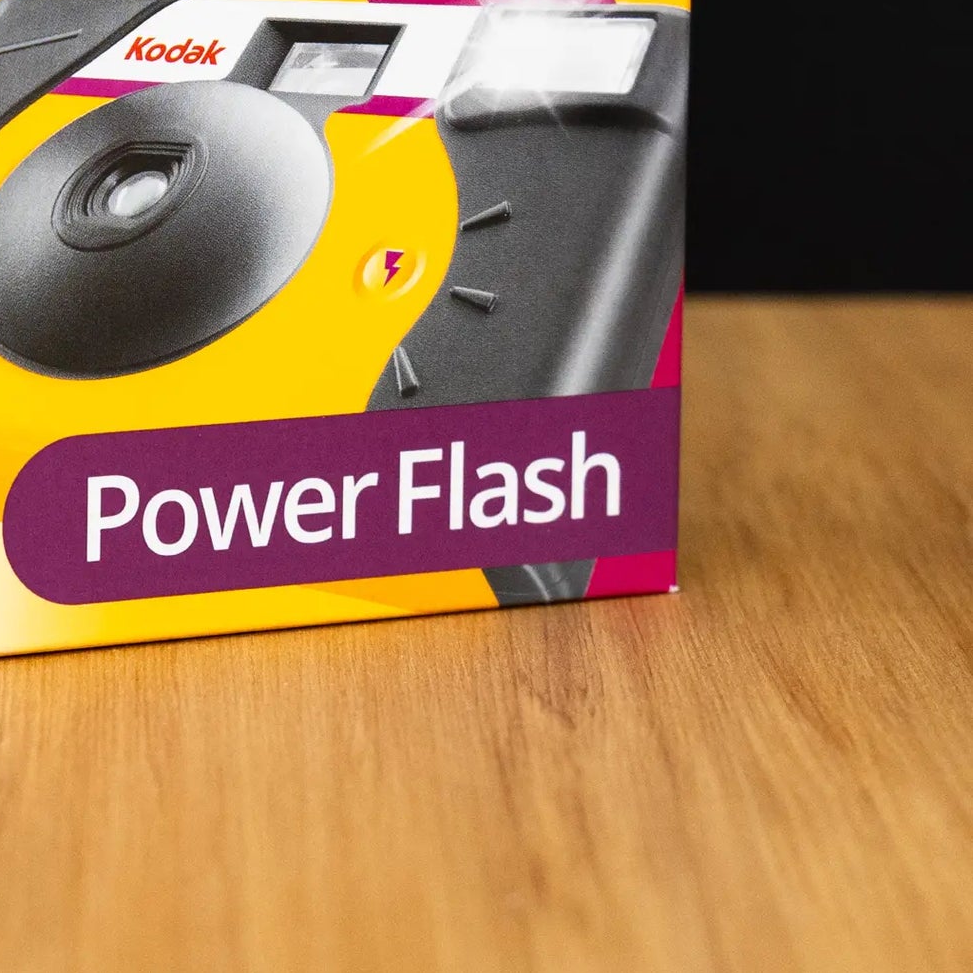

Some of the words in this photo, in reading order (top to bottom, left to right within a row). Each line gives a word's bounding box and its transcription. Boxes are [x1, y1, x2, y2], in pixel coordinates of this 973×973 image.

[124, 36, 226, 66] Kodak
[85, 471, 379, 563] Power
[397, 430, 621, 535] Flash
